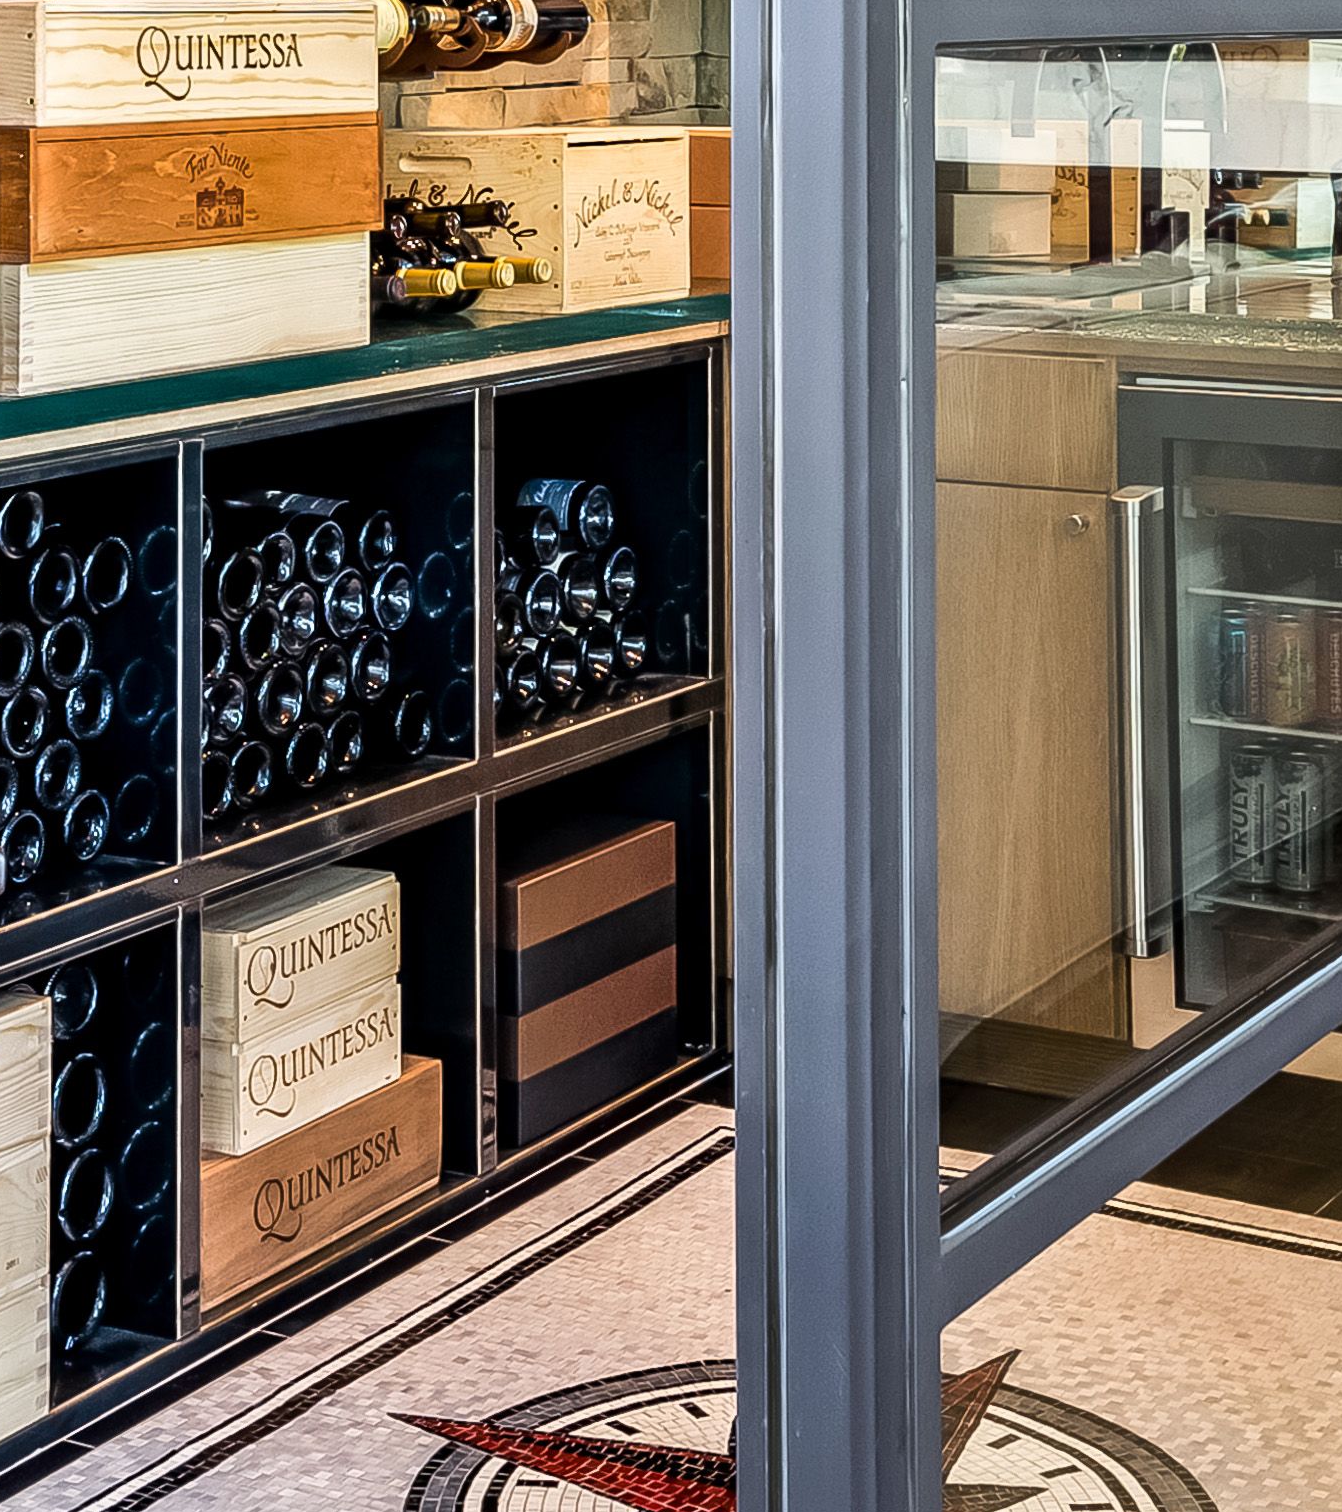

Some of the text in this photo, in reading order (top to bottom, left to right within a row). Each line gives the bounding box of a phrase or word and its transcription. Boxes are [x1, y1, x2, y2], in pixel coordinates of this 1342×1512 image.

[136, 25, 303, 102] QUINTESSA
[185, 142, 254, 183] Far Niente
[1233, 779, 1249, 860] TRULY
[247, 902, 393, 1009] QUINTESSA
[248, 1006, 395, 1118] QUINTESSA
[253, 1125, 402, 1244] QUINTESSA
